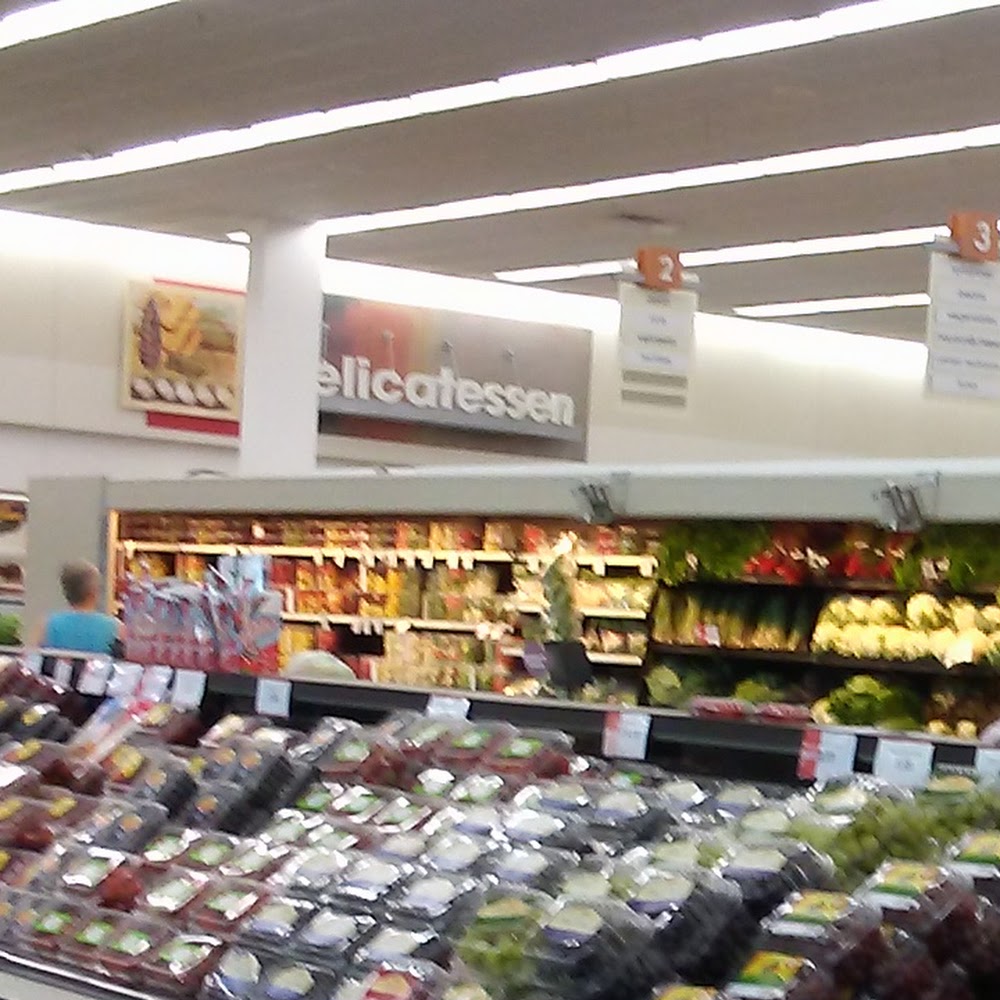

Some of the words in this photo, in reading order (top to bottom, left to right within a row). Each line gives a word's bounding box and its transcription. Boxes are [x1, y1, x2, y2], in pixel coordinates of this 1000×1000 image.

[972, 220, 992, 253] 3
[658, 254, 675, 283] 2
[318, 354, 575, 427] elicatessen
